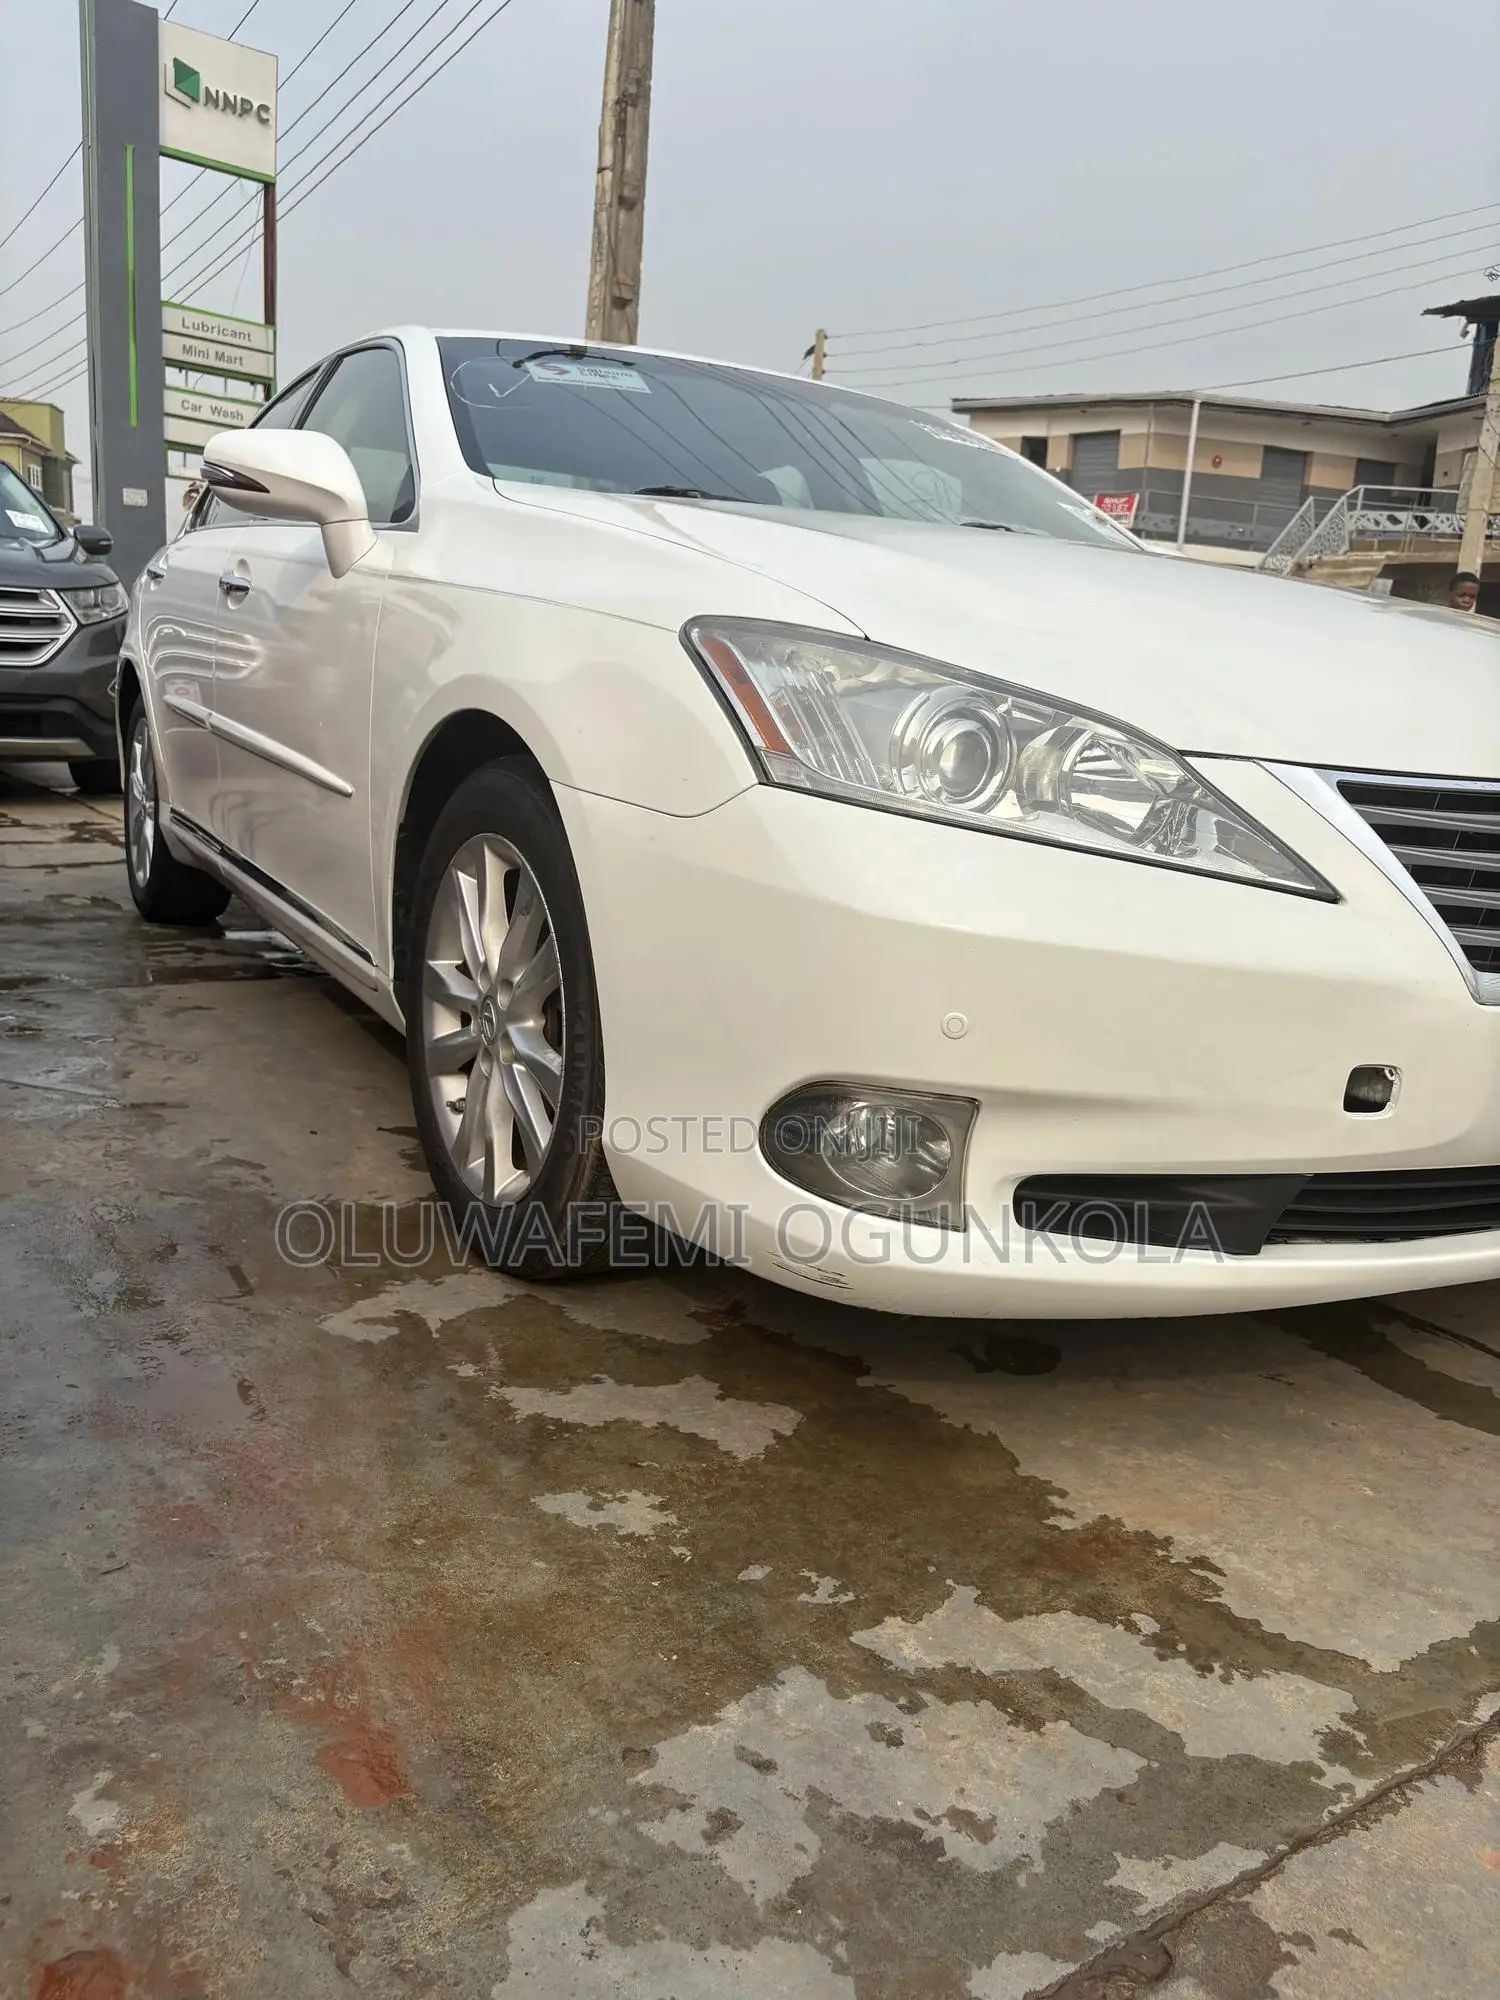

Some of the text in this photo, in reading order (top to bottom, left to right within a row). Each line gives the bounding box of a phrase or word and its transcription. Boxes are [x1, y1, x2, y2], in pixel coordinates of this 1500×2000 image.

[203, 86, 271, 125] NNPC
[181, 317, 252, 342] Lubricant
[182, 343, 244, 366] Mini Mart
[181, 399, 244, 421] Car Wash
